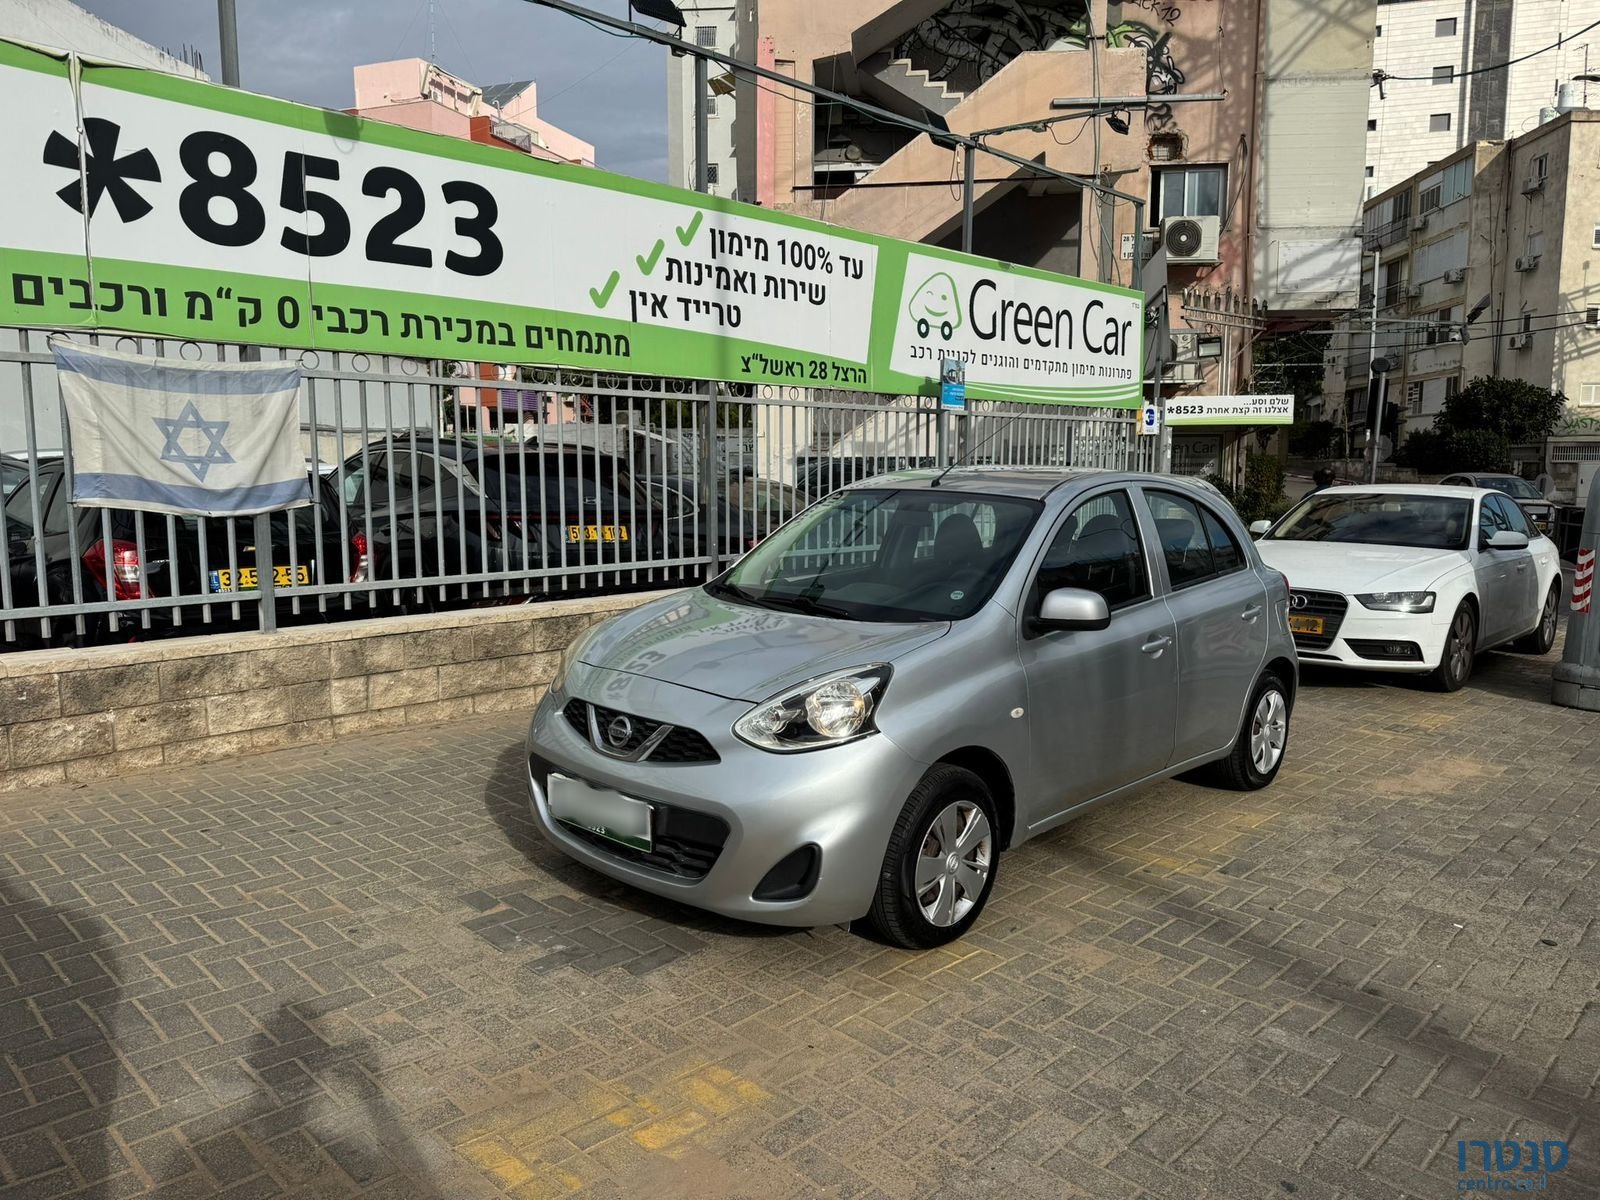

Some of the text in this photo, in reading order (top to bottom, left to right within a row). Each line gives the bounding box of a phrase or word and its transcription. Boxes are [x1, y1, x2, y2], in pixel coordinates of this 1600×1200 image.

[709, 228, 864, 280] עד 100% מימון
[665, 257, 826, 306] שירות ואמינות
[12, 272, 168, 317] ורכבים
[277, 295, 300, 329] 0
[312, 304, 389, 336] רכבי
[629, 289, 742, 328] טרייד אין
[969, 278, 1132, 357] Green Car
[400, 312, 516, 347] במכירת
[525, 325, 631, 358] מתמחים
[910, 345, 932, 360] רכב
[808, 360, 828, 380] 28
[981, 352, 1019, 369] והוגנים
[1023, 358, 1068, 375] מתקדמים
[1072, 363, 1095, 378] מימון
[832, 361, 867, 384] הרצל
[1098, 366, 1132, 380] פתרונות
[1231, 406, 1250, 415] קצת
[1264, 406, 1289, 414] אצלנו
[1269, 397, 1289, 405] שלם
